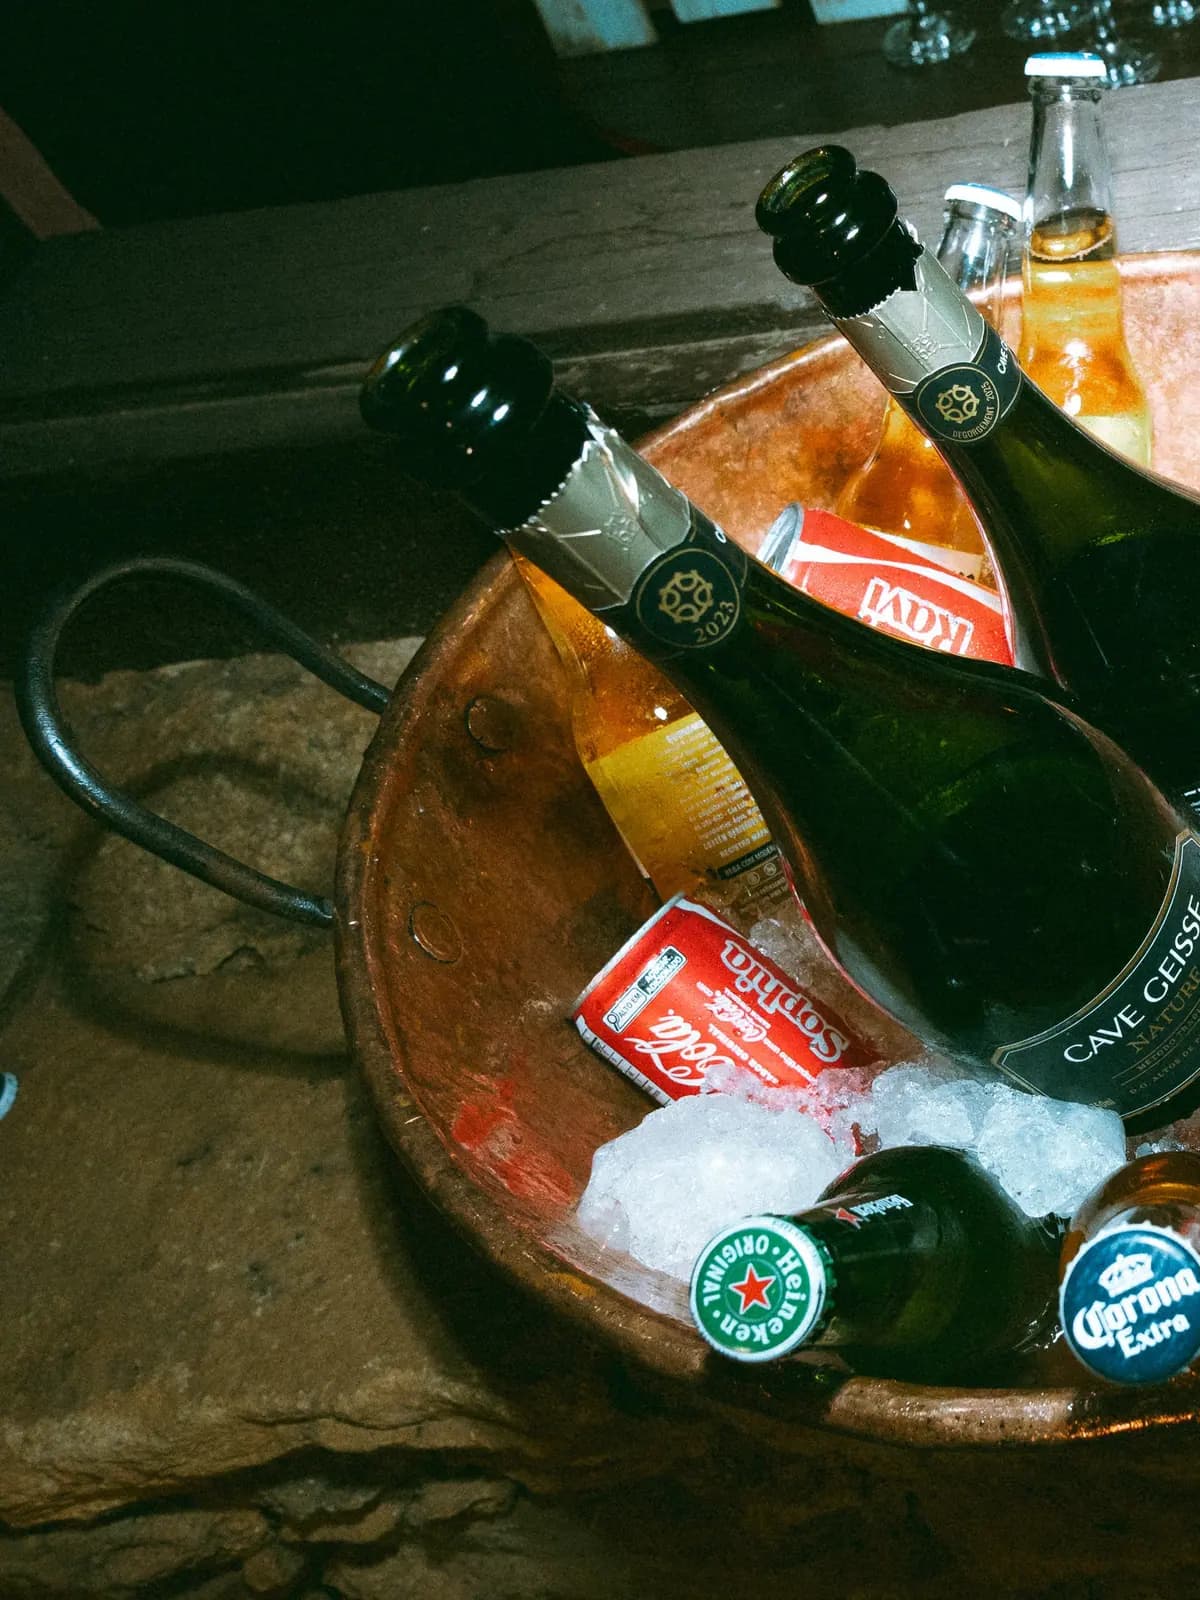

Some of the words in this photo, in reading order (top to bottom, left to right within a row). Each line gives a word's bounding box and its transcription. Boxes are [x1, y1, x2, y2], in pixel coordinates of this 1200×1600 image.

[693, 600, 736, 643] 2023
[619, 1002, 633, 1018] ALTO
[703, 990, 767, 1043] Coca-Cola
[720, 939, 849, 1063] Sophia
[1063, 1003, 1146, 1063] CAVE
[703, 1235, 769, 1307] ORIGINAL
[720, 1248, 806, 1345] Heineken
[1116, 1314, 1190, 1358] Extra
